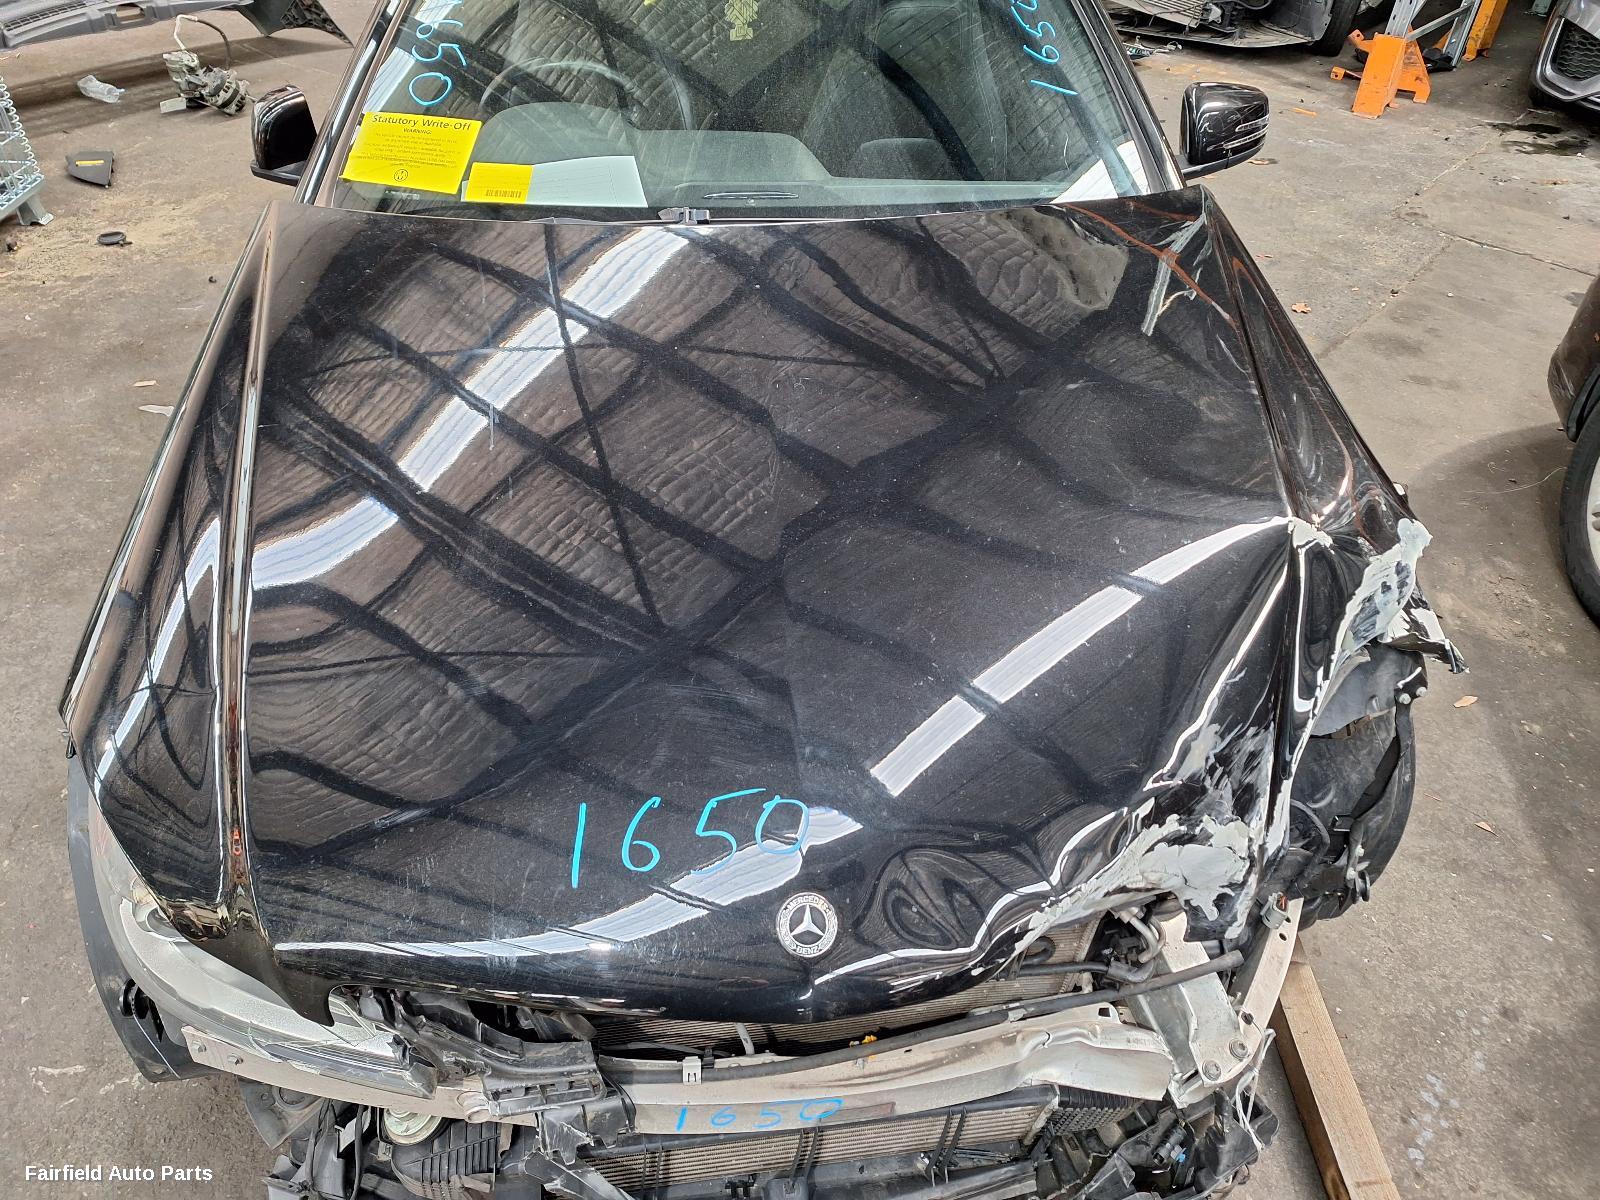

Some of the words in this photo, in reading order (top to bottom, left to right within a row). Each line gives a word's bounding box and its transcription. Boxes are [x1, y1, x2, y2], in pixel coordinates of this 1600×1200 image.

[408, 0, 467, 107] 650
[371, 114, 419, 127] Statutory
[422, 118, 471, 131] Write-Off
[571, 788, 809, 889] 1650
[796, 945, 820, 955] BENZ
[675, 1098, 845, 1132] 1650
